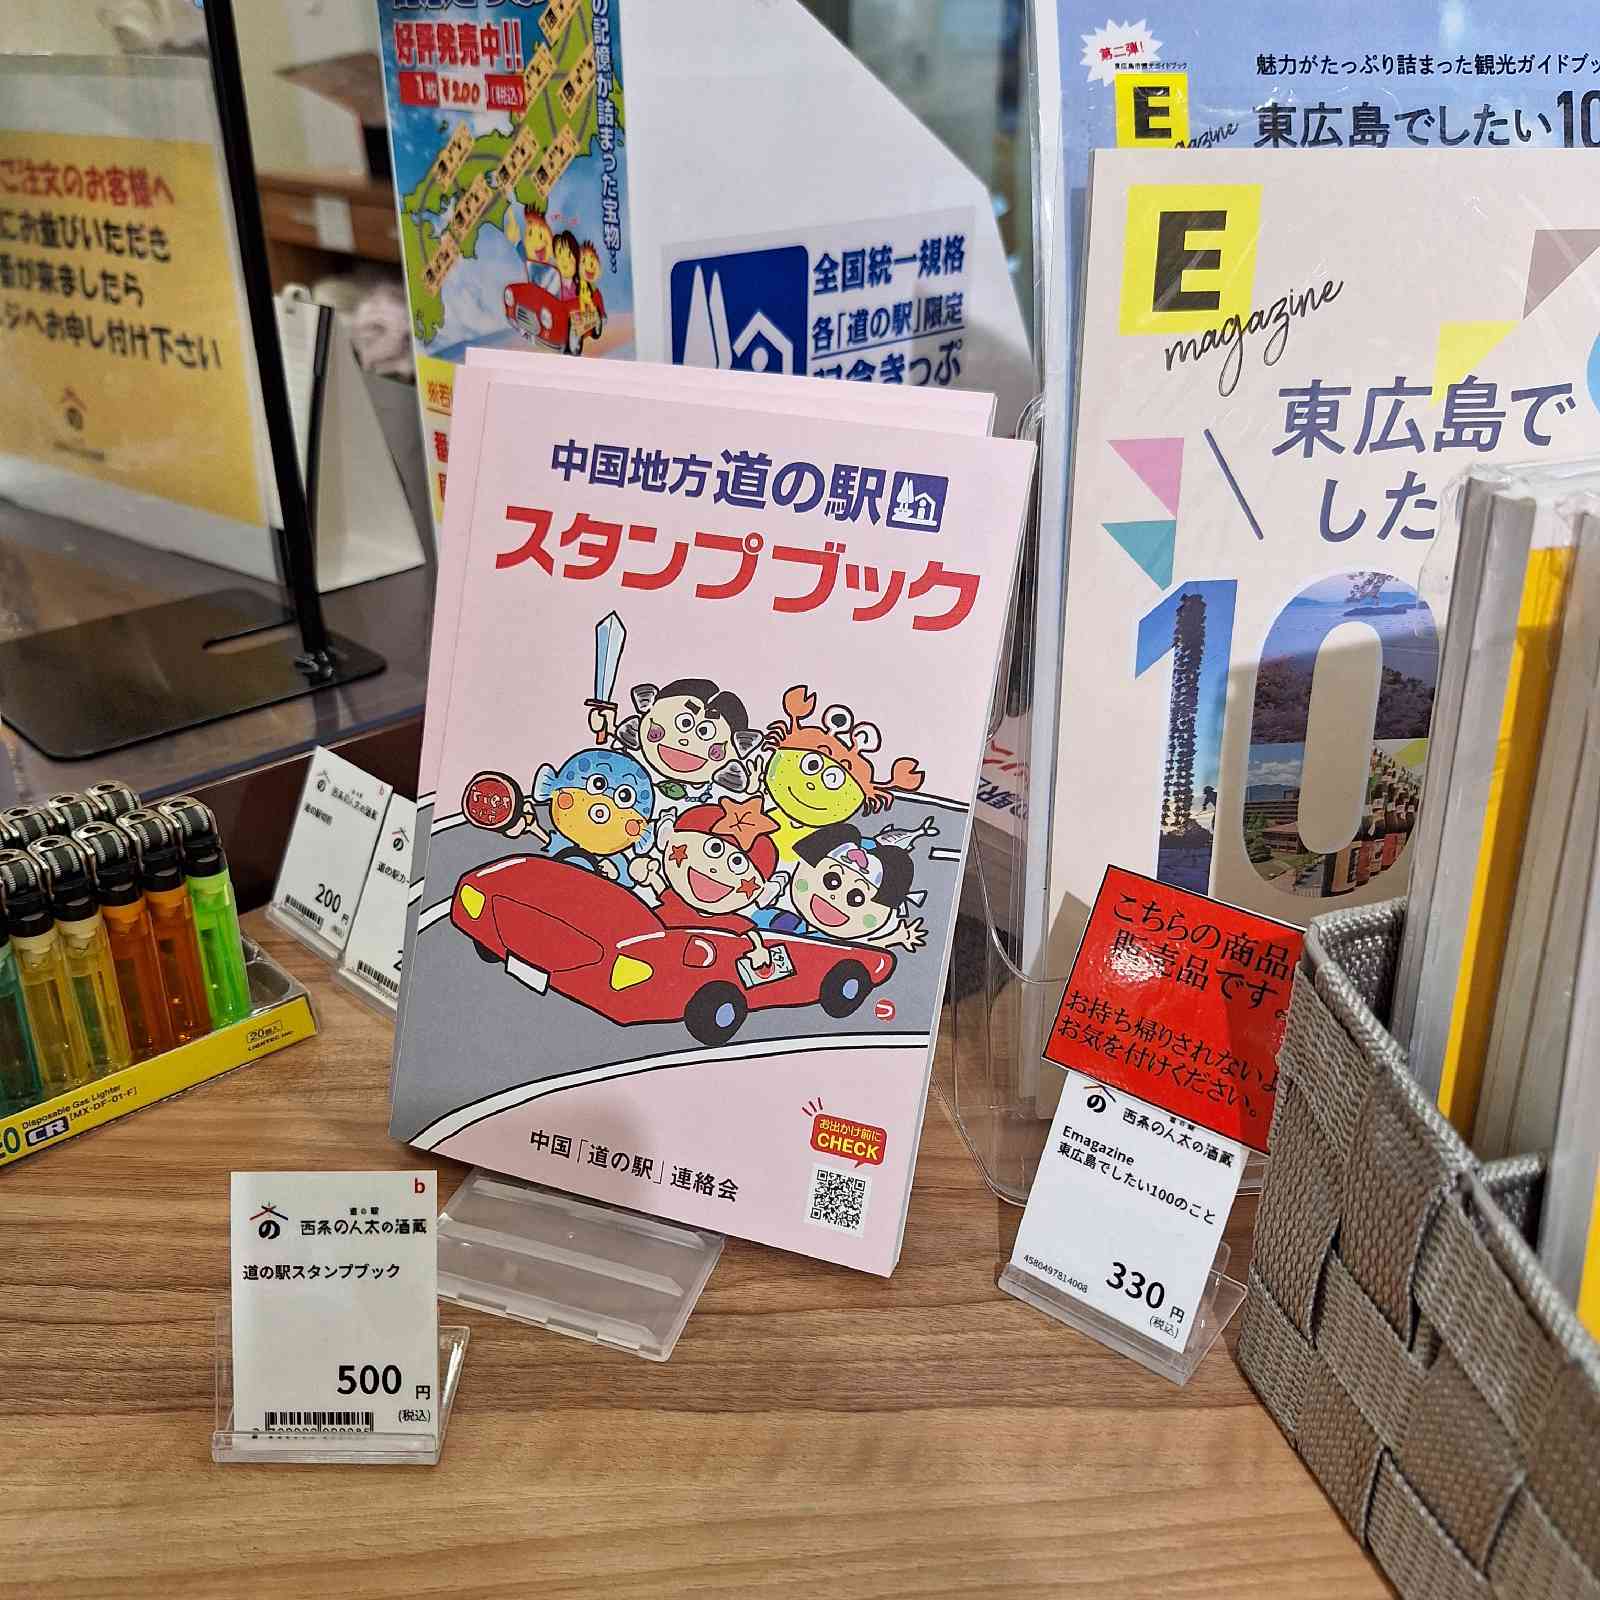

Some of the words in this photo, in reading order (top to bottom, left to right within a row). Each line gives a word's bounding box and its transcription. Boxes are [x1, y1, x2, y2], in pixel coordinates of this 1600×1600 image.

[1133, 86, 1172, 139] E
[813, 234, 967, 296] 全国統一規格
[1152, 210, 1228, 312] E
[812, 292, 965, 353] 各「道の駅」限定
[1164, 279, 1344, 398] magazine
[1272, 375, 1576, 459] 東広島で
[551, 440, 887, 526] 中国地方道の駅
[496, 505, 981, 632] スタンプブック
[315, 883, 341, 914] 200
[1113, 891, 1294, 981] こちらの商品
[1057, 1015, 1258, 1119] お気を付けください。
[72, 1097, 89, 1109] Gas
[28, 1118, 66, 1144] CR
[816, 1133, 881, 1162] CHECK
[819, 1117, 882, 1143] お出かけ前に
[1063, 1125, 1135, 1166] Emagazine
[1122, 1107, 1235, 1168] 西条のん太の酒蔵
[414, 1178, 426, 1194] b
[530, 1129, 740, 1203] 中国「道の駅」連絡会
[1056, 1141, 1216, 1226] 東広島でしたい100のこと
[300, 1218, 428, 1236] 西条のん太の酒蔵
[242, 1263, 401, 1281] 道の駅スタンプブック
[1023, 1253, 1089, 1294] 4580497814008
[1105, 1261, 1166, 1310] 330
[1169, 1306, 1185, 1323] 円
[1148, 1314, 1180, 1340] (税込)
[337, 1364, 402, 1395] 500
[415, 1384, 431, 1400] 円
[398, 1409, 431, 1423] (税込)
